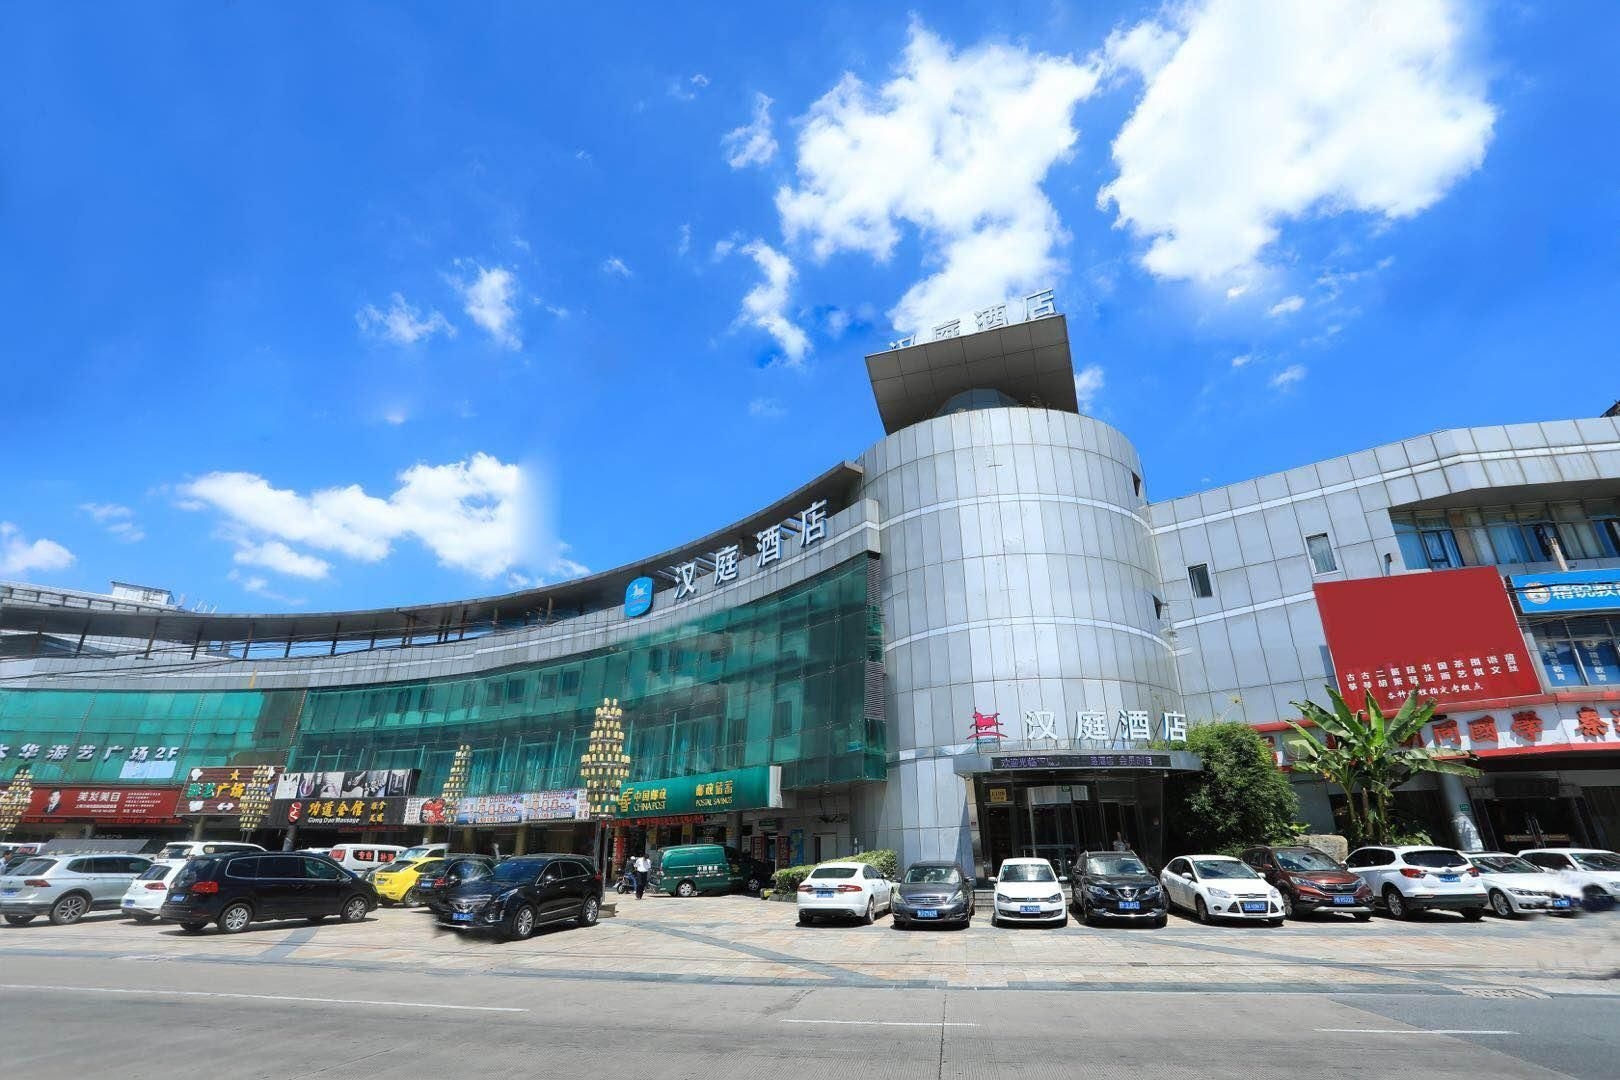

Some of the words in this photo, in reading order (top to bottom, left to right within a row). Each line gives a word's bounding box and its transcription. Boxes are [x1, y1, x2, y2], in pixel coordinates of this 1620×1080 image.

[673, 499, 828, 600] 汉庭酒店
[1387, 681, 1484, 700] 各种程指定考级点
[1023, 708, 1188, 743] 汉庭酒店
[634, 788, 667, 802] 中国邮政
[695, 780, 733, 797] 邮政储蓄
[633, 802, 650, 811] CHINA
[651, 801, 666, 810] POST
